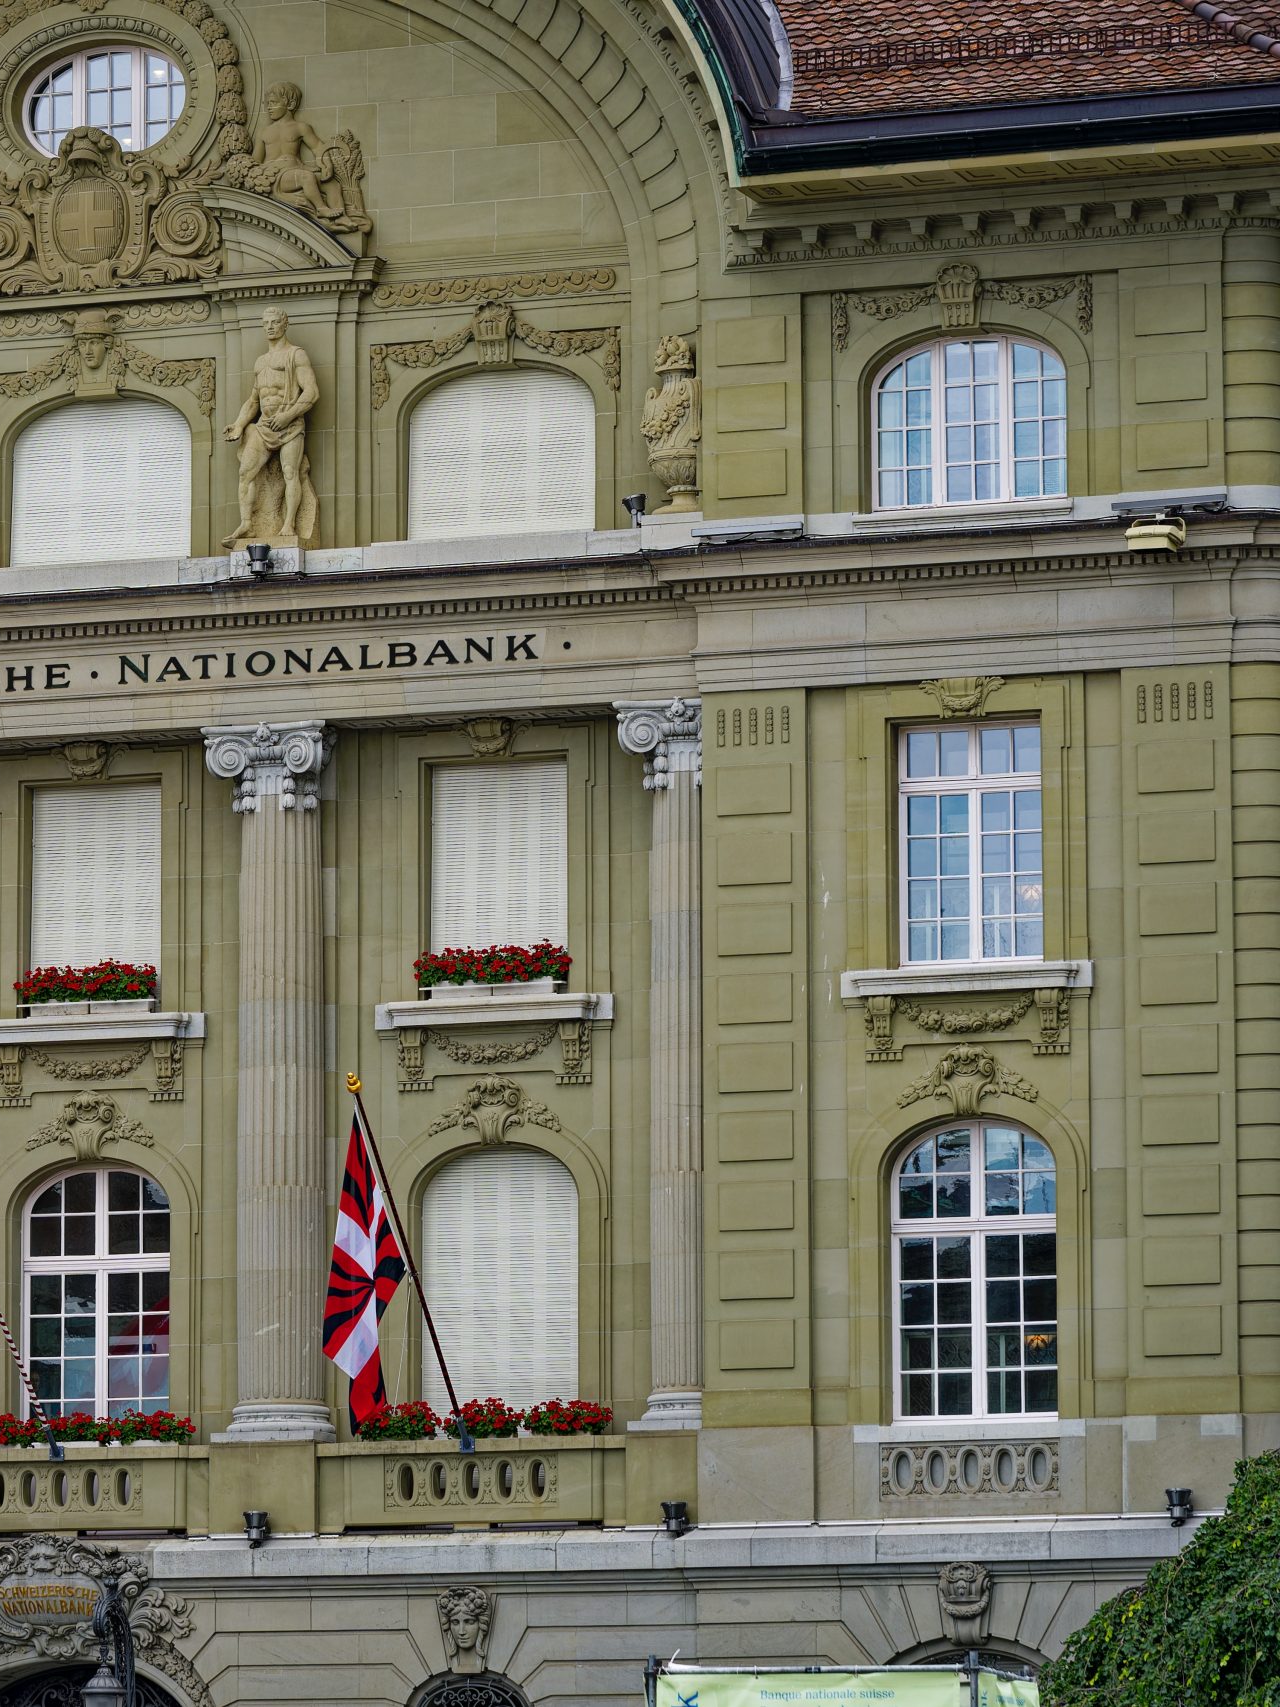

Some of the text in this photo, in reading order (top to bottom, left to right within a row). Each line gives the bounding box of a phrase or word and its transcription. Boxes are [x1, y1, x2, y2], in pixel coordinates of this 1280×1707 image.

[117, 633, 539, 685] NATIONALBANK
[2, 1599, 96, 1616] NATIONALBANK
[760, 1688, 896, 1702] Banque nationale suisse
